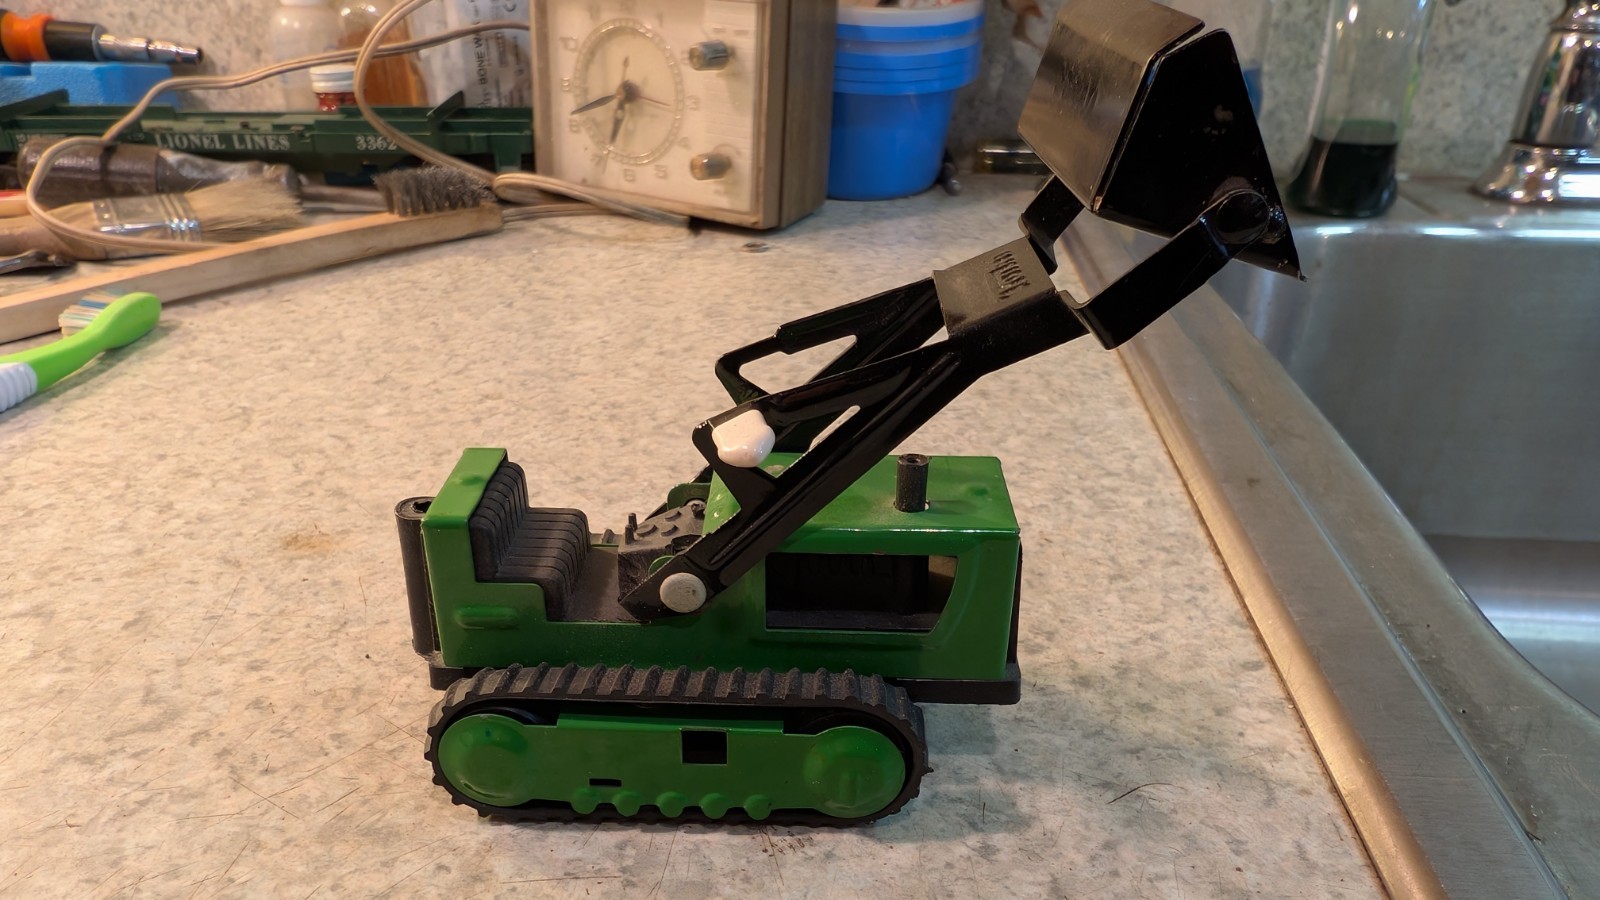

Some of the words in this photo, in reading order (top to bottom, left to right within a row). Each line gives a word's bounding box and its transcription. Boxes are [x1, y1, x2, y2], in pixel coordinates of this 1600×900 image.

[155, 133, 226, 150] LIONEL
[233, 134, 290, 150] LINES
[355, 135, 397, 151] 3362
